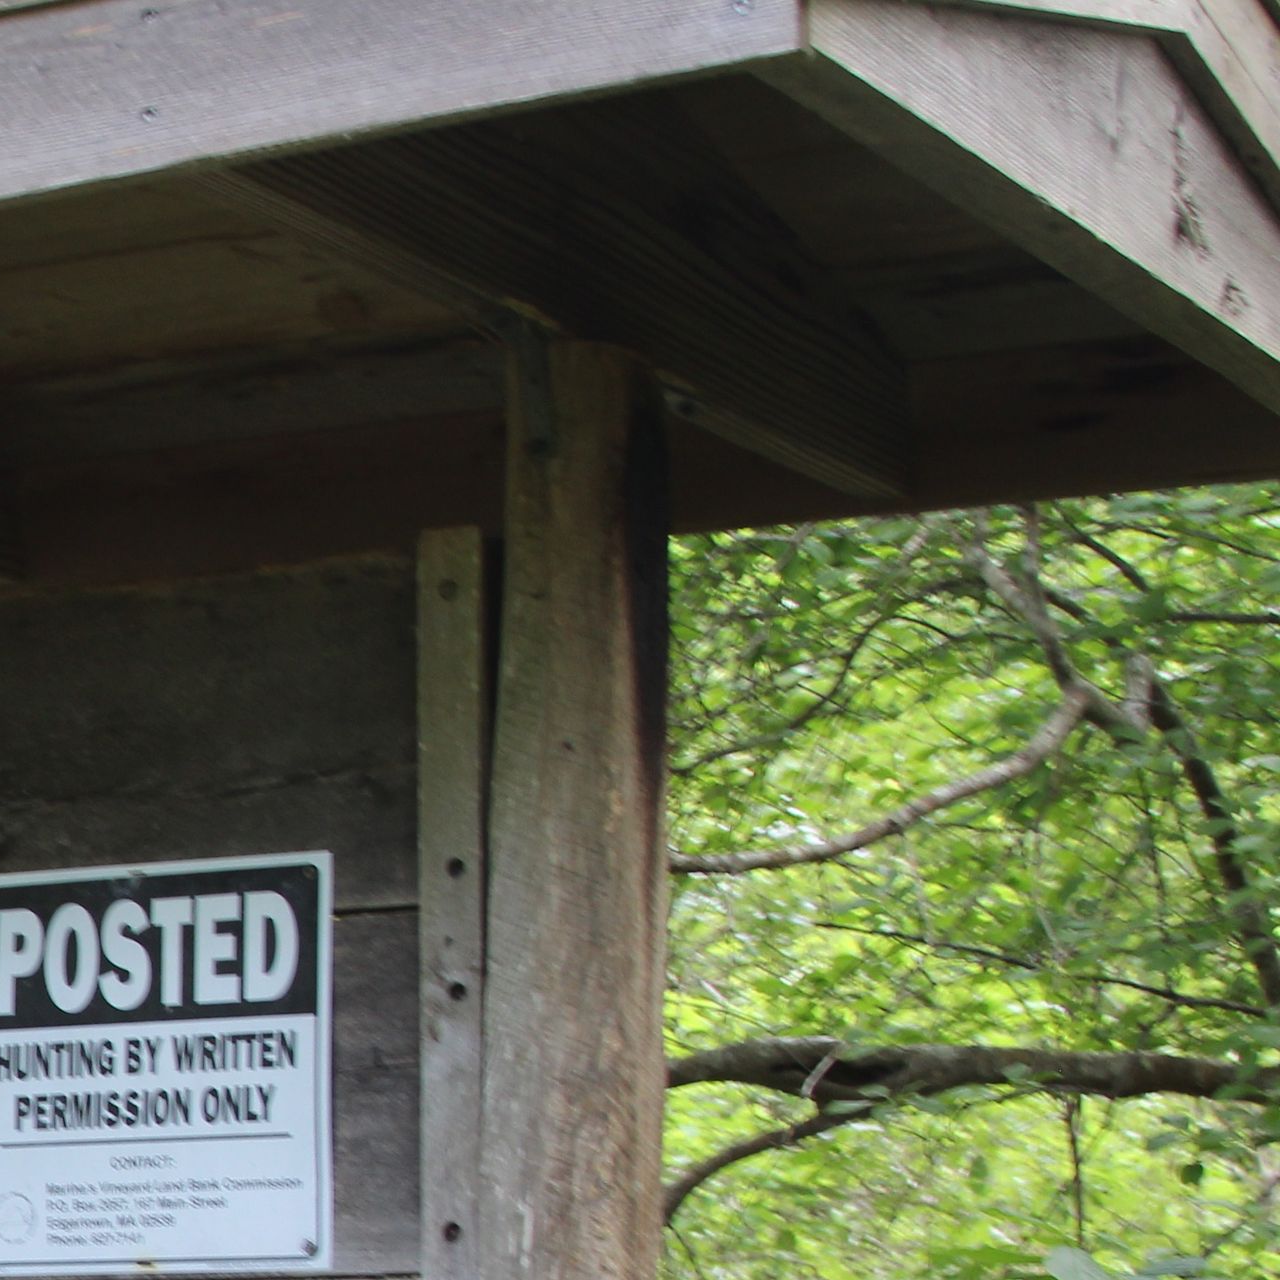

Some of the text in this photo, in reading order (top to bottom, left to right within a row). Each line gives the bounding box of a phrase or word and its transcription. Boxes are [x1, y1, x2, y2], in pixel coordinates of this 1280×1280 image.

[124, 1036, 162, 1076] BY
[172, 1029, 299, 1073] WRITTEN
[13, 1084, 276, 1132] PERMISSION ONLY
